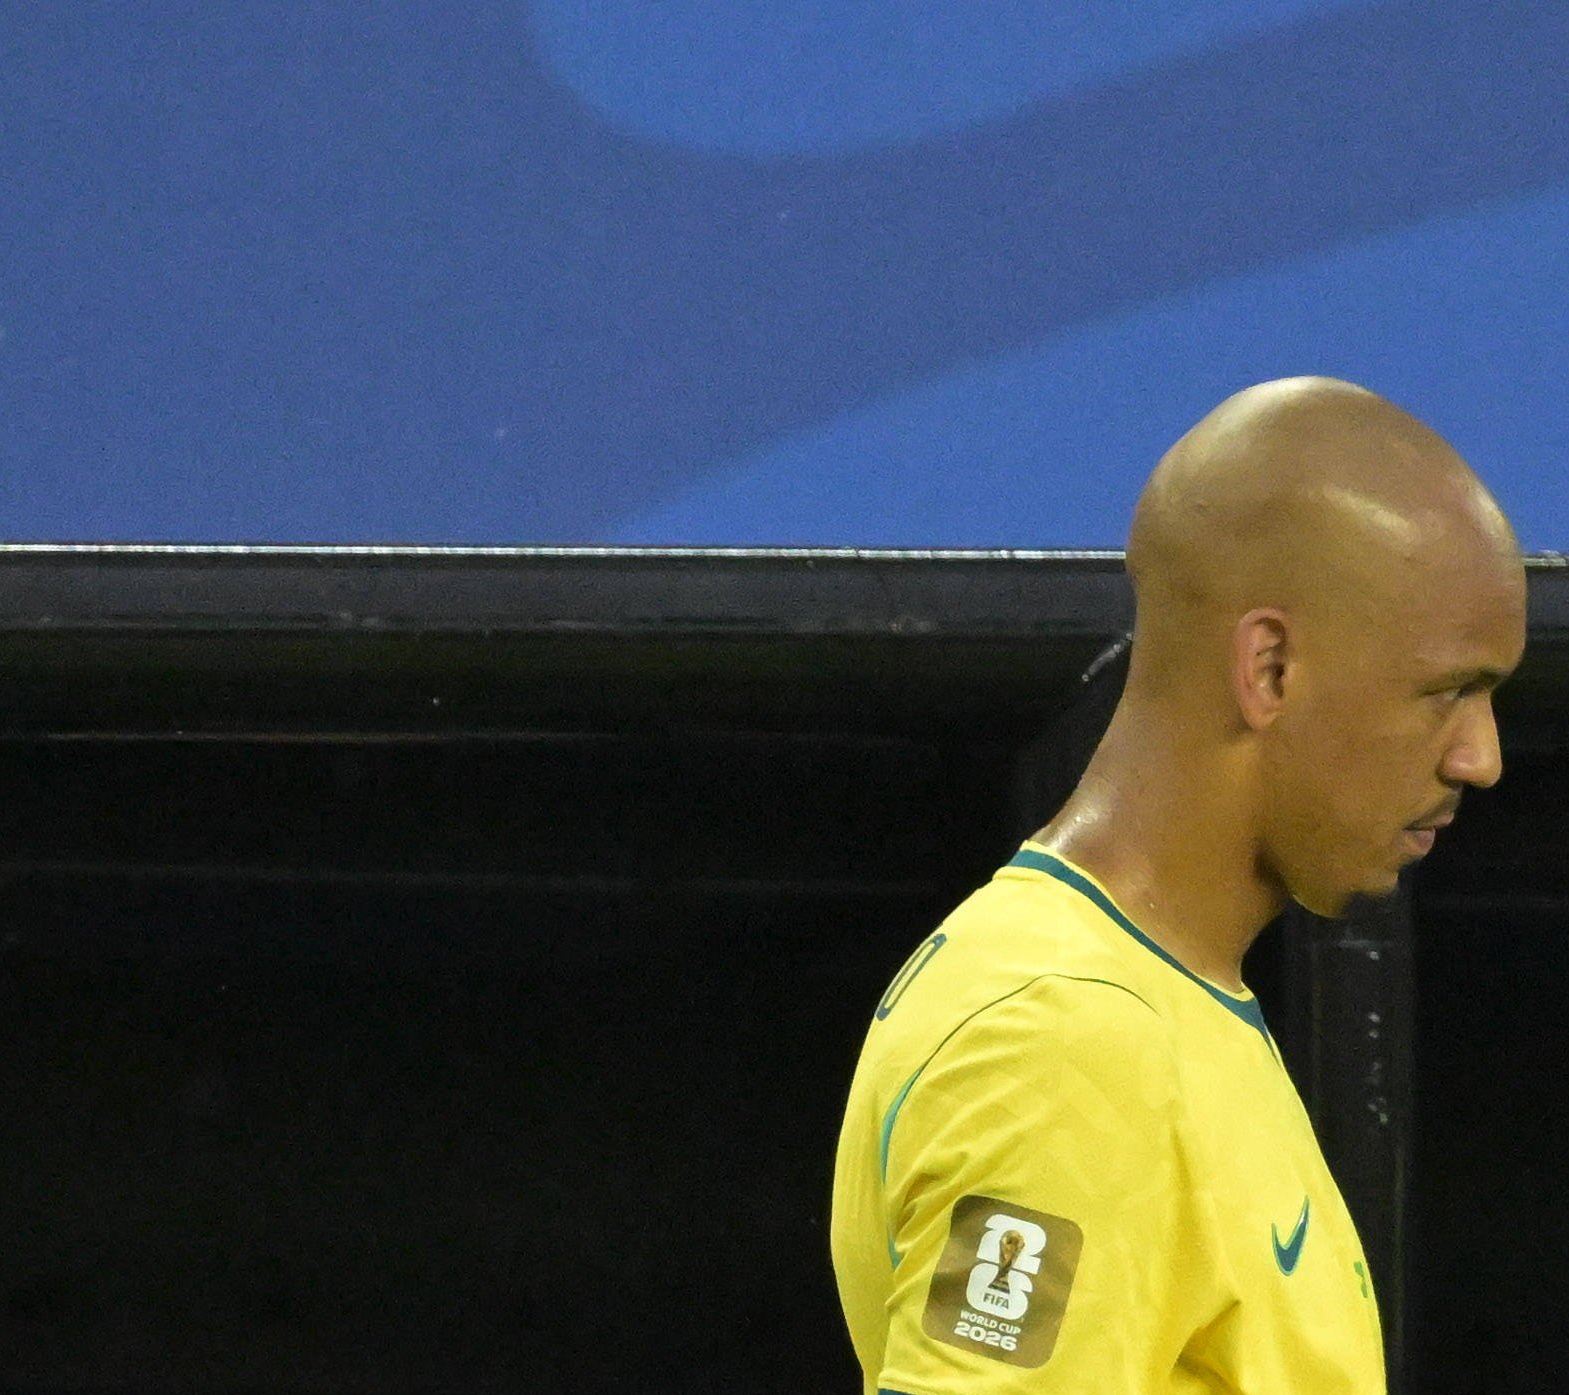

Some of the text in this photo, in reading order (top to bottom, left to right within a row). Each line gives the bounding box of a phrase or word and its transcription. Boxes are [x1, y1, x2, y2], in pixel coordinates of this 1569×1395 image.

[983, 1292, 1010, 1311] FIFA
[959, 1309, 1022, 1336] WORLD CUP
[953, 1321, 1018, 1352] 2026
